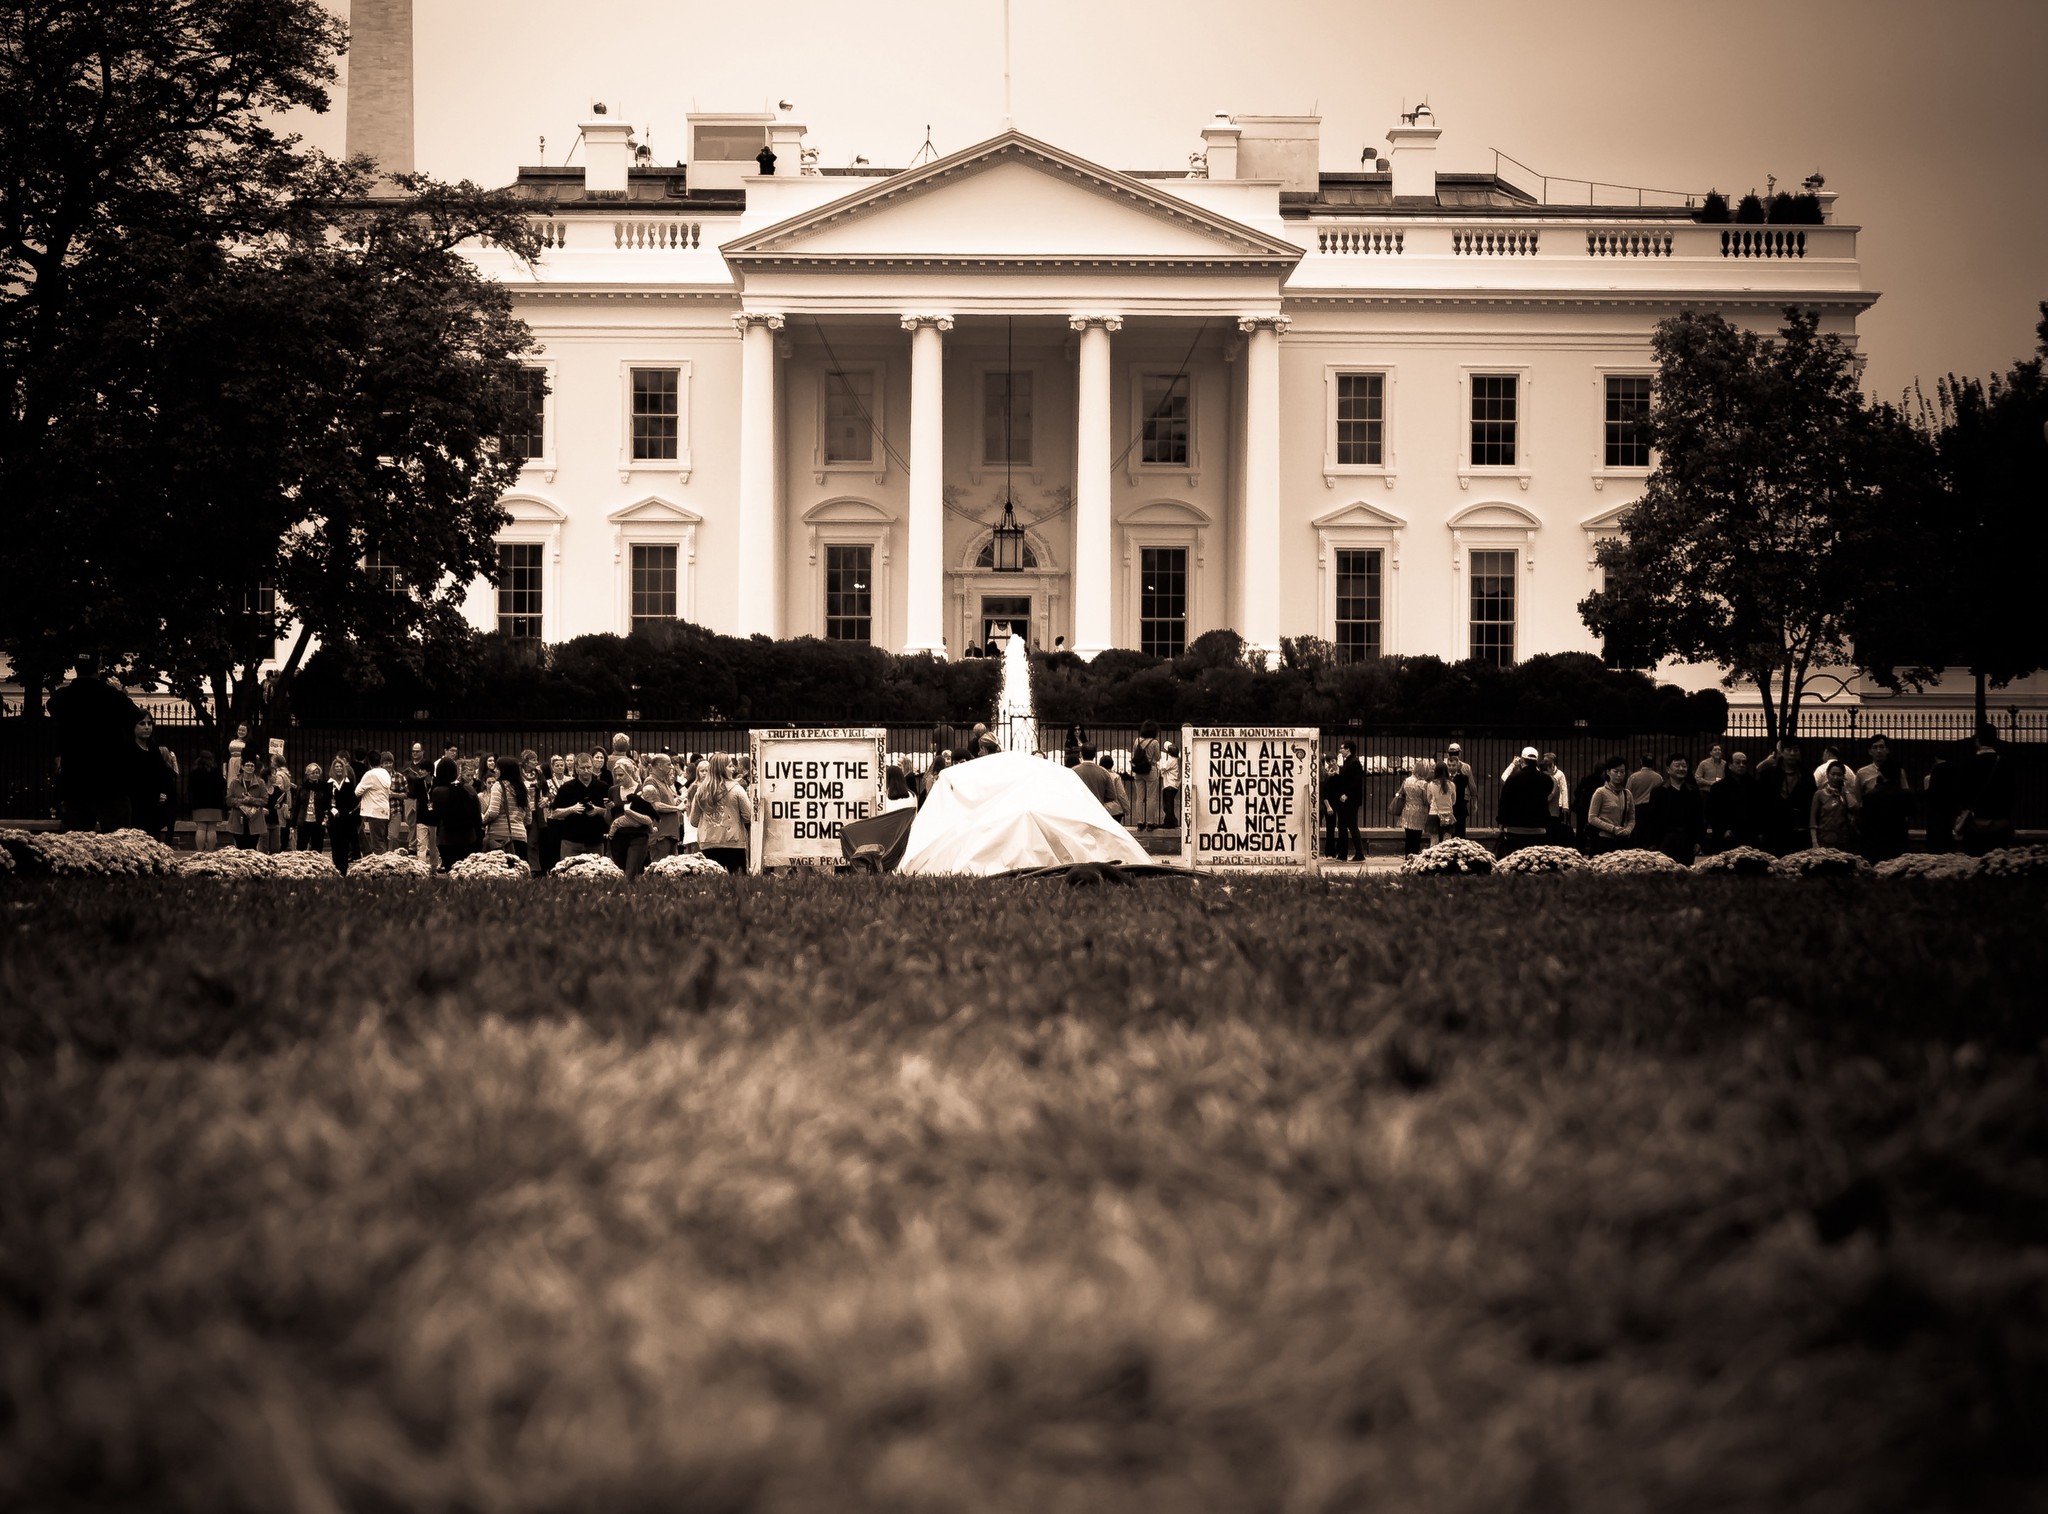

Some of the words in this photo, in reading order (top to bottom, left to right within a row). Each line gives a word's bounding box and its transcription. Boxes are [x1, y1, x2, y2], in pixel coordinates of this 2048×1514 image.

[768, 730, 799, 739] TRUTH
[800, 730, 806, 738] &
[807, 729, 839, 738] PEACE
[842, 729, 867, 738] VIGIL
[1201, 728, 1236, 738] MAYER
[1239, 728, 1296, 737] MONUMENT
[1210, 740, 1248, 760] BAN
[1258, 740, 1293, 760] ALL
[766, 762, 803, 780] LIVE
[807, 762, 830, 780] BY
[833, 762, 869, 780] THE
[1210, 760, 1294, 778] NUCLEAR
[794, 782, 844, 799] BOMB
[1209, 779, 1294, 796] WEAPONS
[772, 802, 801, 819] DIE
[807, 802, 829, 819] BY
[833, 802, 870, 820] THE
[1209, 797, 1234, 815] OR
[1245, 797, 1293, 815] HAVE
[794, 822, 844, 840] BOMB
[1217, 816, 1228, 833] A
[1245, 815, 1287, 833] NICE
[1199, 834, 1298, 852] DOOMSDAY
[789, 857, 815, 866] WAGE
